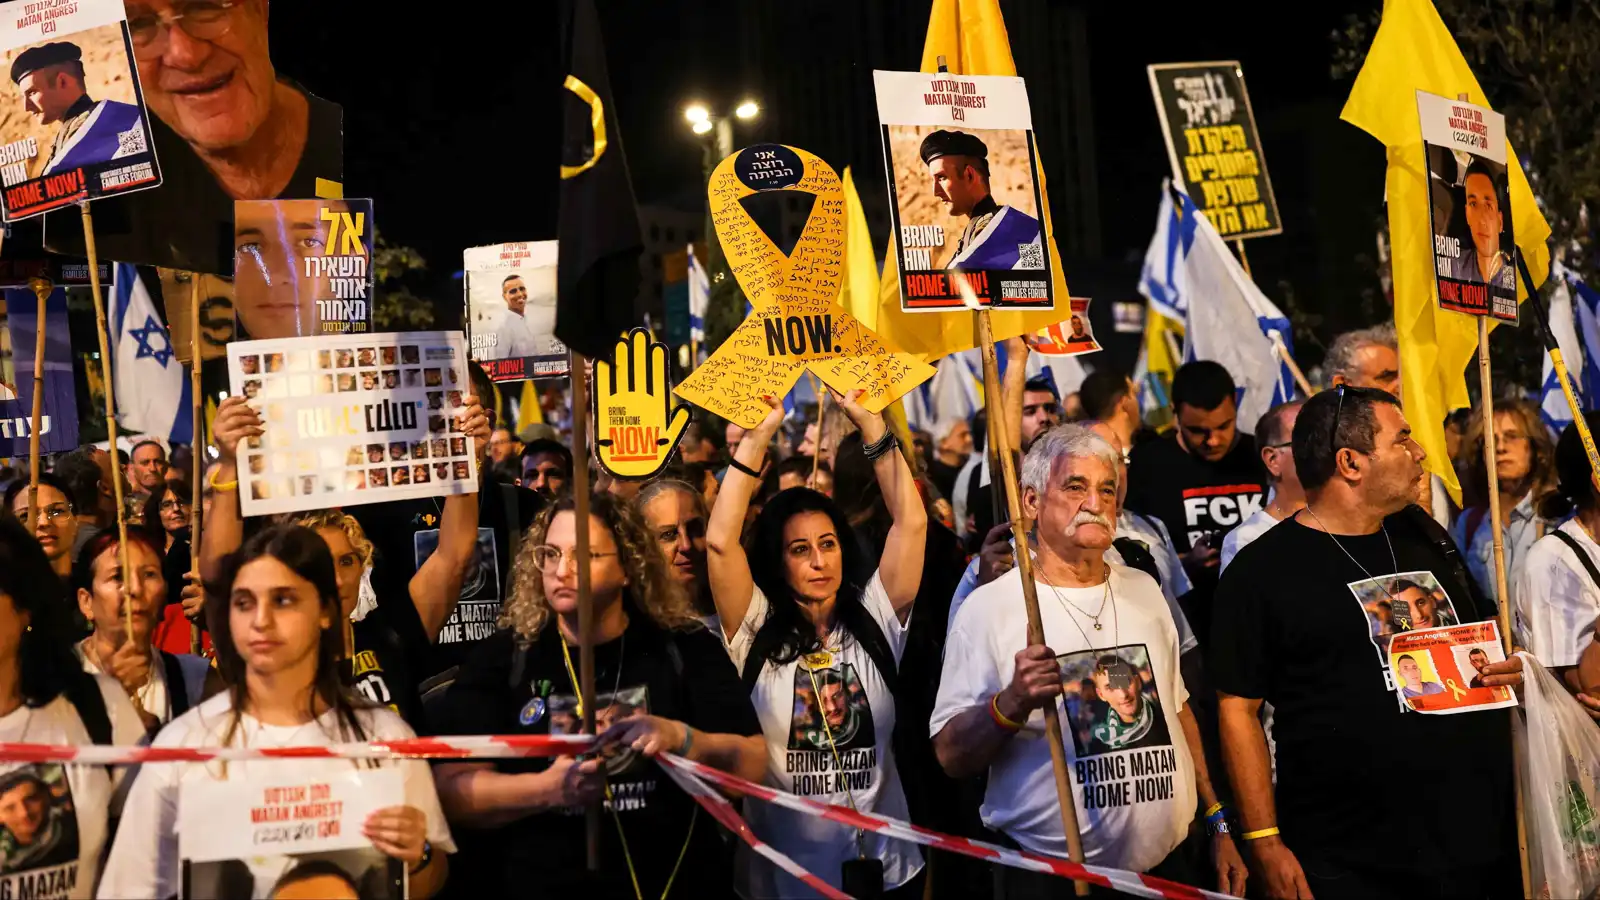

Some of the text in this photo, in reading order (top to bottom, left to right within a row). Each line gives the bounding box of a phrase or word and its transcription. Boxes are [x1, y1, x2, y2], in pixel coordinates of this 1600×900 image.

[17, 14, 42, 29] MATAN
[44, 2, 78, 20] ANGREST
[41, 20, 56, 35] (21)
[931, 80, 976, 95] מתן אנגרסט
[924, 94, 986, 108] MATAN ANGREST
[952, 106, 965, 122] (21)
[1449, 117, 1468, 131] MATAN
[0, 137, 38, 165] BRING
[755, 151, 776, 159] אני
[1, 162, 28, 187] HIM
[749, 168, 794, 180] הביתה
[752, 160, 784, 170] רוצה
[6, 167, 86, 210] HOME NOW!
[101, 168, 154, 189] FAMILIES FORUM
[822, 200, 843, 208] איתן
[320, 207, 365, 255] אל
[900, 225, 944, 247] BRING
[1435, 234, 1460, 258] BRING
[304, 257, 366, 277] תשאירו
[903, 249, 931, 270] HIM
[1437, 256, 1452, 278] HIM
[330, 278, 366, 299] אותי
[816, 279, 836, 288] אלון
[906, 274, 947, 297] HOME
[1002, 288, 1048, 298] FAMILIES FORUM
[1440, 279, 1460, 303] HOME
[1462, 284, 1488, 307] NOW!
[316, 300, 366, 320] מאחור
[322, 322, 366, 332] מתן אנגרסט
[764, 315, 841, 356] NOW.
[472, 333, 498, 349] BRING
[498, 357, 524, 374] NOW!
[608, 406, 626, 416] BRING
[609, 416, 641, 425] THEM HOME
[609, 426, 660, 455] NOW
[1184, 493, 1263, 526] FCK
[1424, 631, 1450, 641] Angrest
[786, 748, 876, 773] BRING MATAN
[1075, 749, 1177, 784] BRING MATAN
[793, 771, 871, 796] HOME NOW!
[1083, 775, 1174, 809] HOME NOW!
[251, 801, 343, 823] MATAN ANGREST
[19, 865, 78, 900] MATAN
